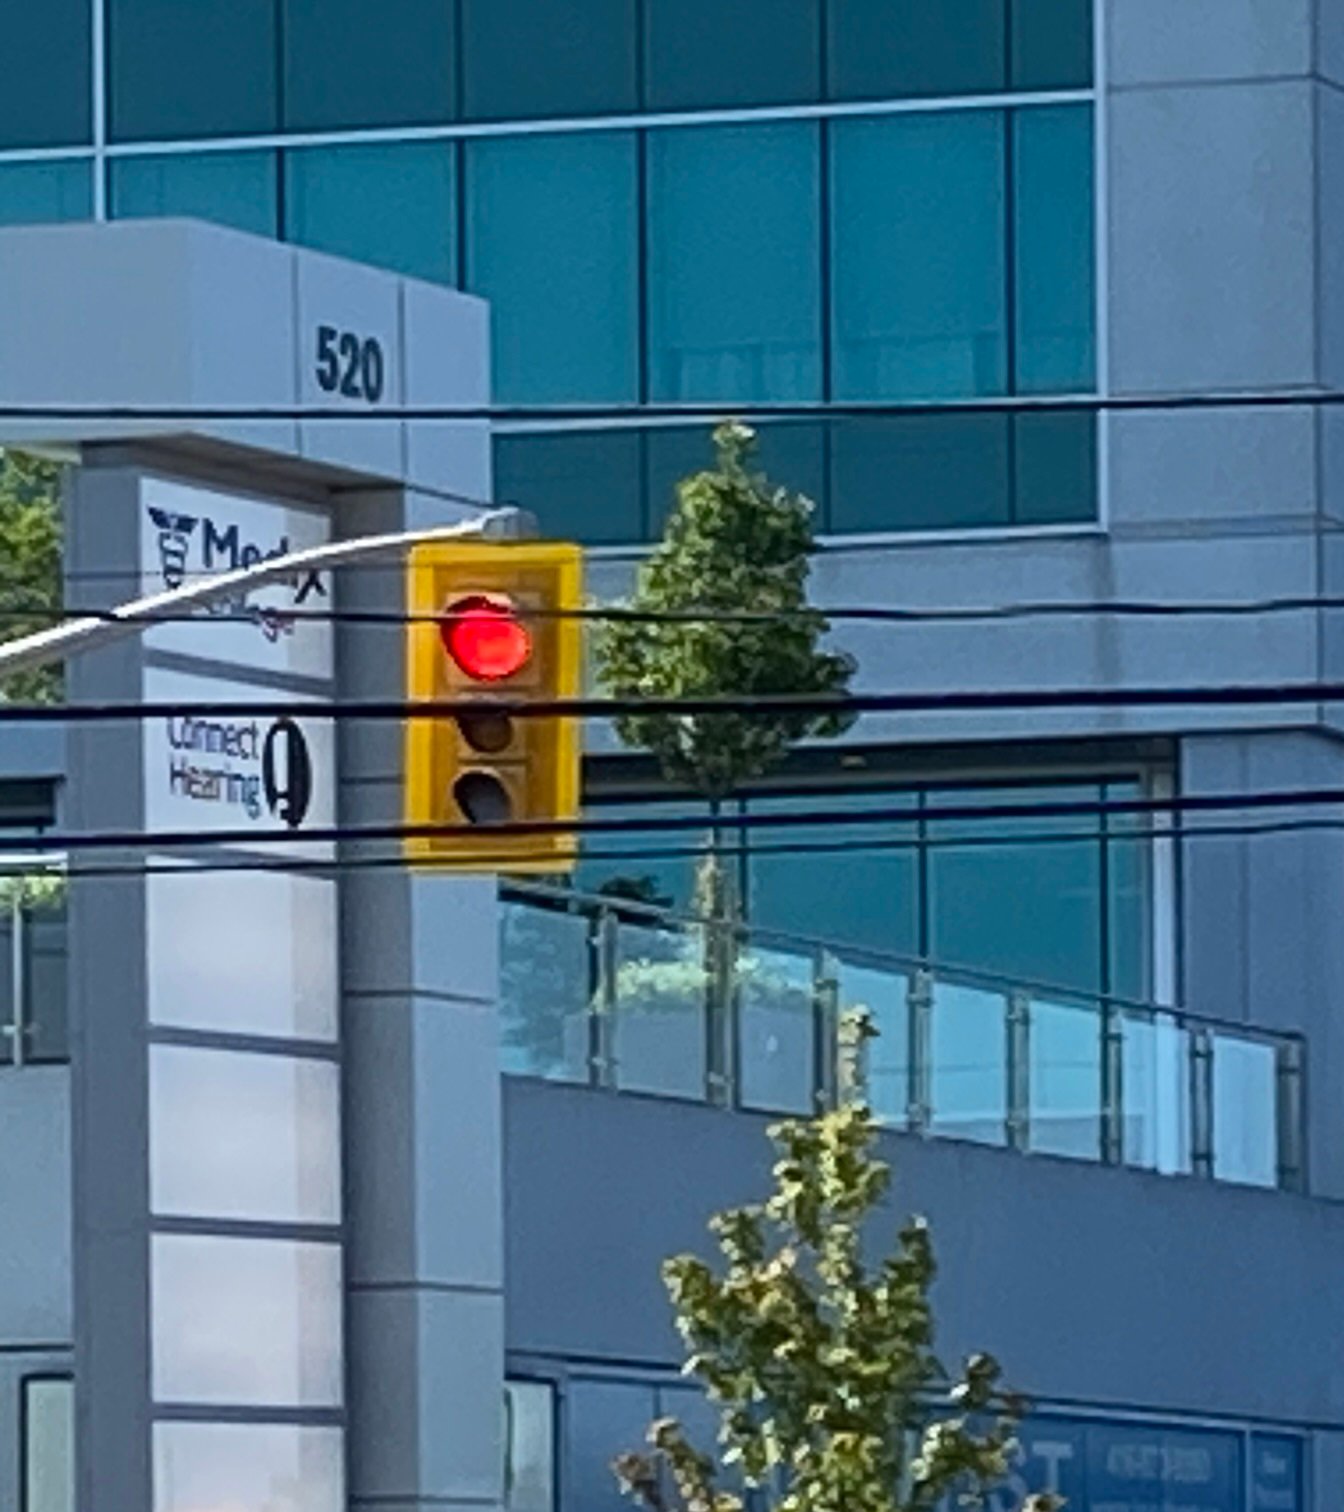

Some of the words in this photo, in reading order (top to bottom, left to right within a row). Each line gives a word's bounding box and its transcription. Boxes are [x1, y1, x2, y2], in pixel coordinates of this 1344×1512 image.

[316, 325, 384, 403] 520
[167, 714, 260, 760] Connect
[169, 756, 261, 820] Hearing
